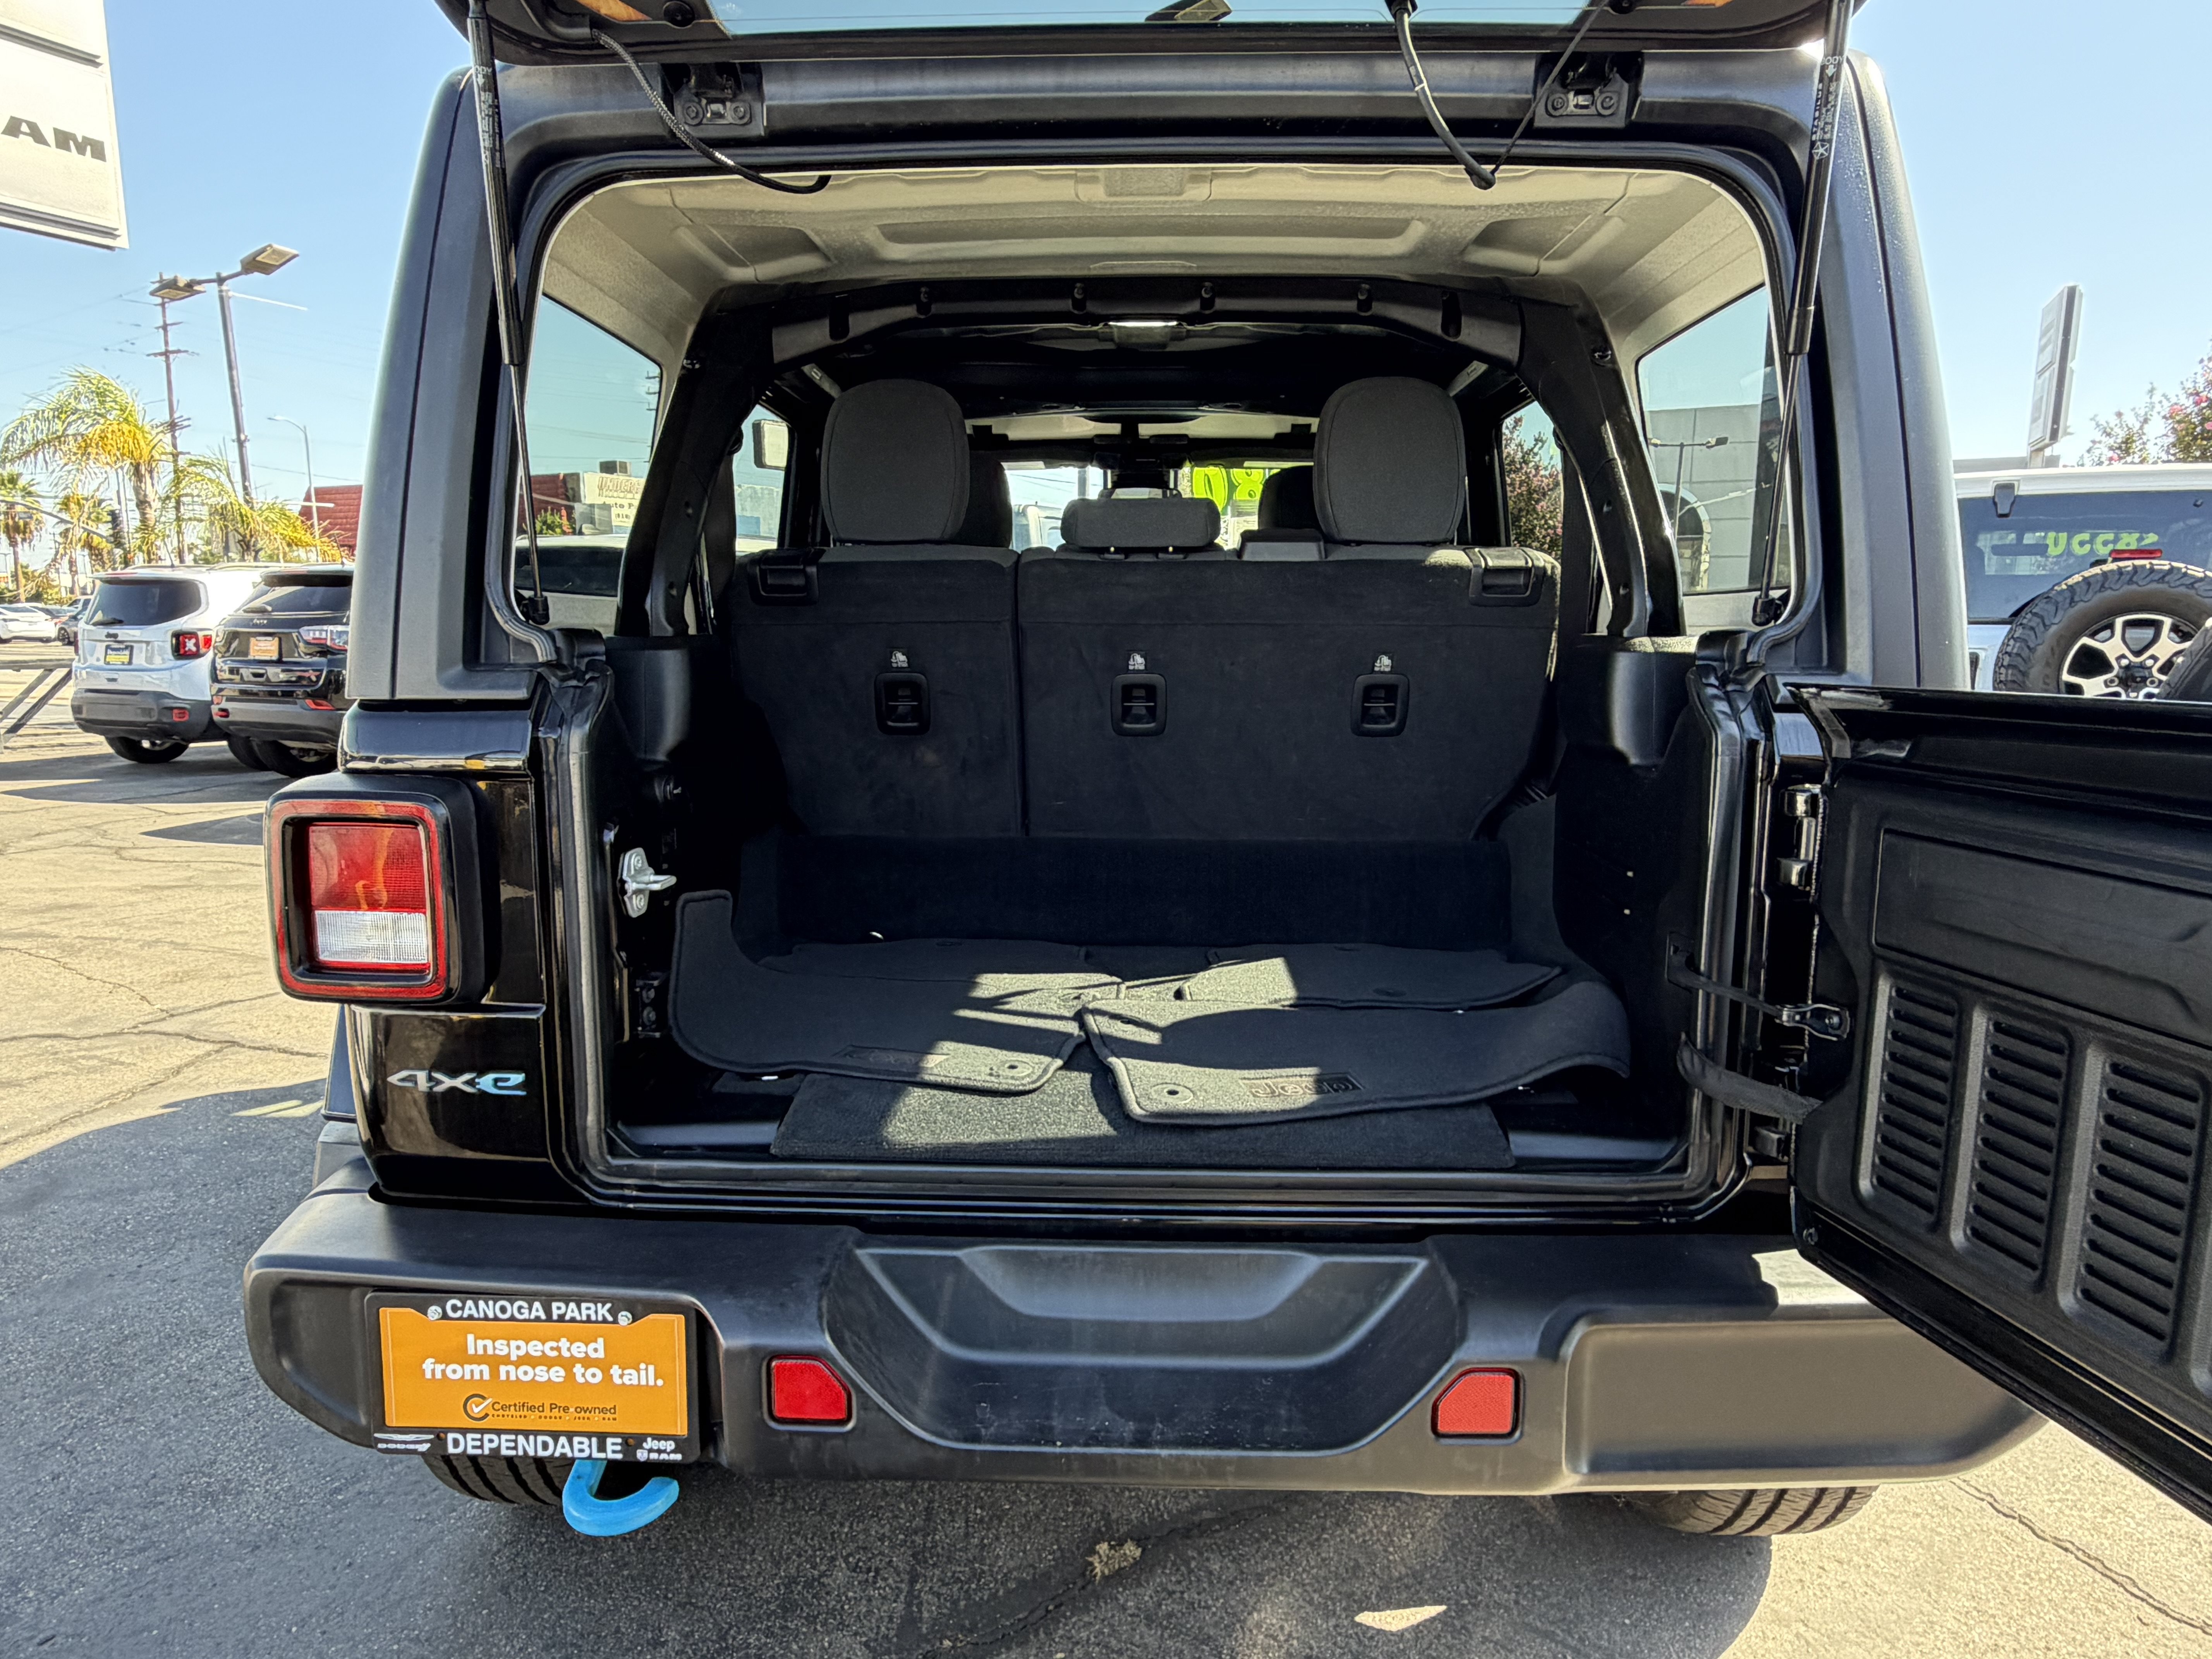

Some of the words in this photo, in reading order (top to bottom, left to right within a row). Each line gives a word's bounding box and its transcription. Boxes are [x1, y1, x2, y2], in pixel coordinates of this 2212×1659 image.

[474, 65, 493, 75] ODY
[1, 115, 106, 162] AM
[446, 1299, 547, 1320] CANOGA
[552, 1302, 614, 1323] PARK
[467, 1333, 605, 1360] Inspected
[422, 1358, 490, 1381] from
[499, 1364, 565, 1383] nose
[574, 1363, 603, 1384] to
[610, 1364, 664, 1387] tail.
[491, 1401, 544, 1413] Certified
[550, 1403, 617, 1415] Pre-owned
[447, 1433, 623, 1460] DEPENDABLE
[642, 1437, 675, 1452] Jeep
[649, 1452, 682, 1460] RAM
